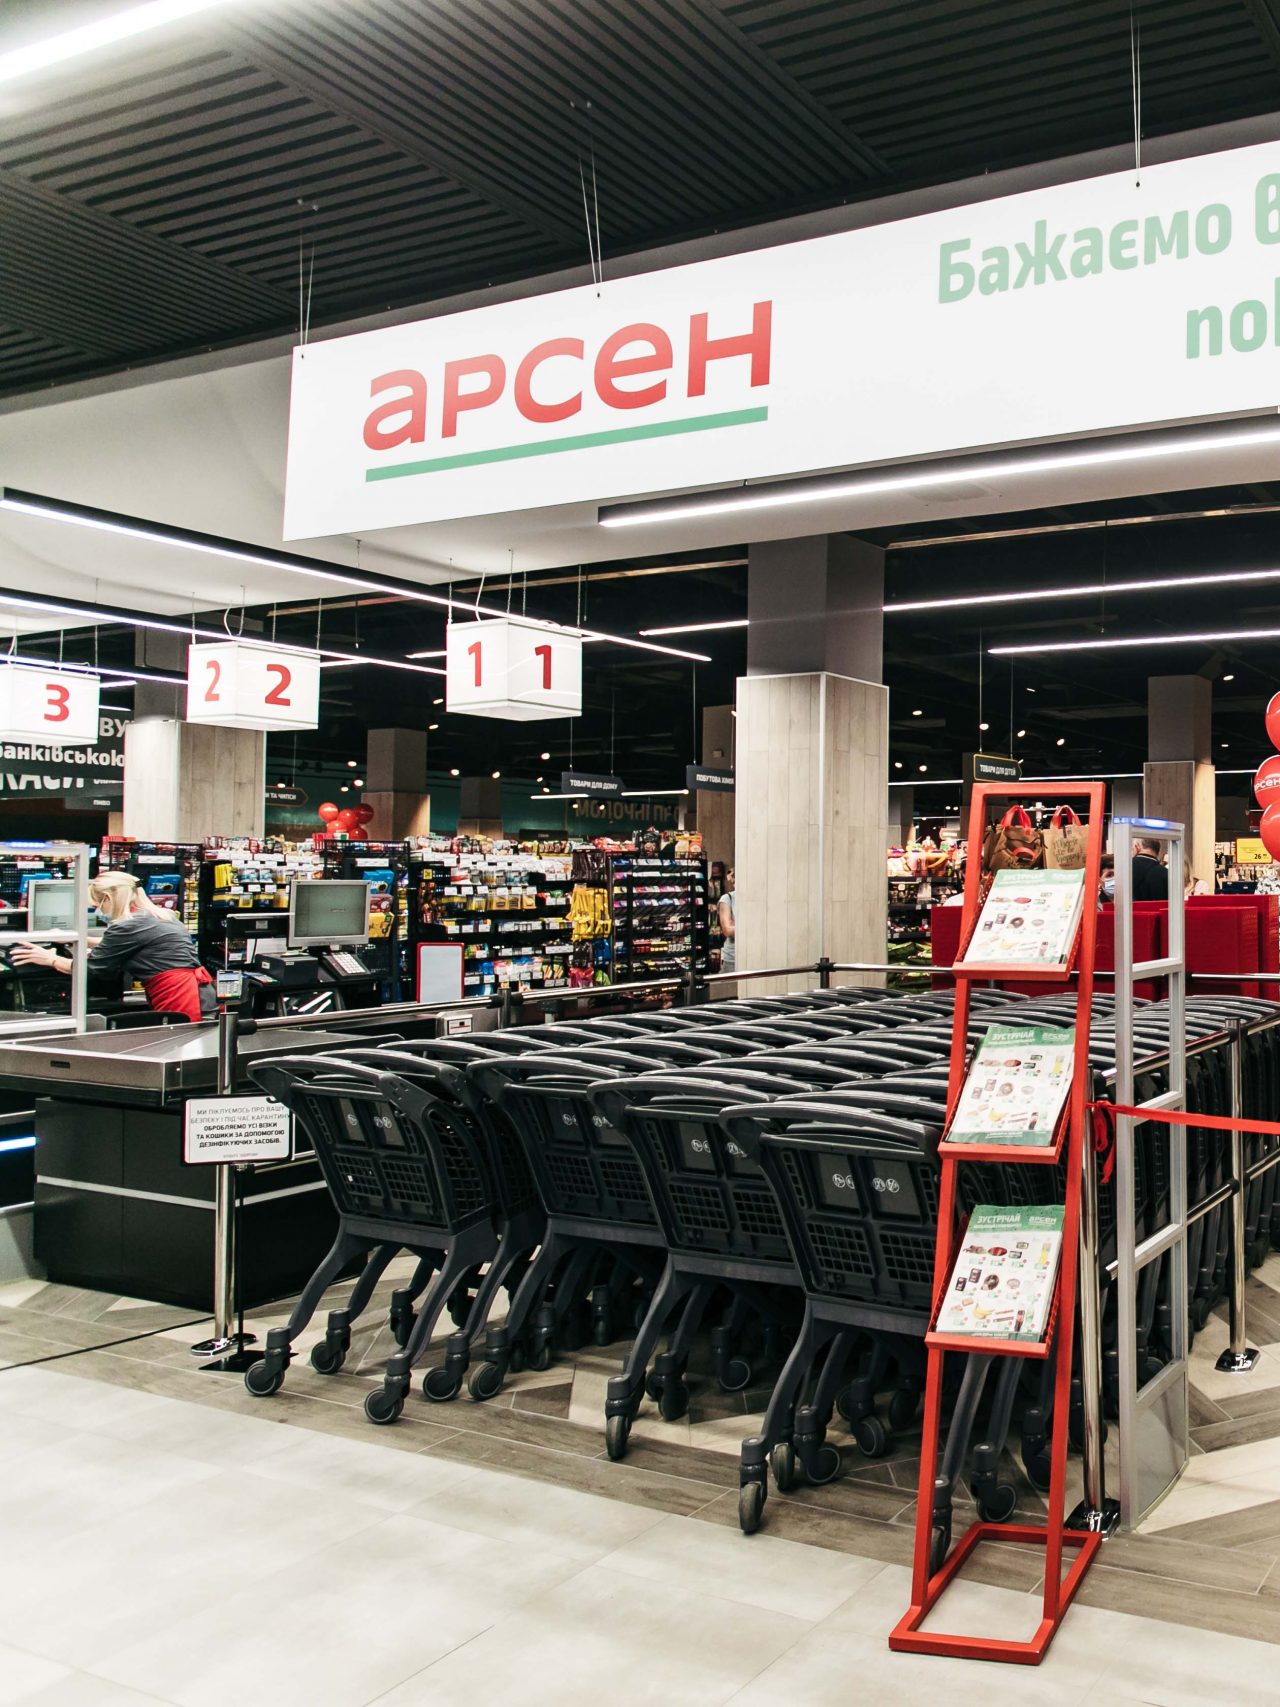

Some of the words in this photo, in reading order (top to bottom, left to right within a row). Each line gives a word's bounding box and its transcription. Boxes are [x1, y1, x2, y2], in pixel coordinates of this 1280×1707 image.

[937, 202, 1232, 304] Бажаємо
[205, 660, 221, 702] 2
[265, 664, 292, 706] 2
[468, 641, 481, 687] 1
[535, 645, 551, 690] 1
[44, 684, 70, 722] 3
[0, 743, 125, 768] анківською
[244, 1129, 285, 1138] ДОПОМОГОЮ
